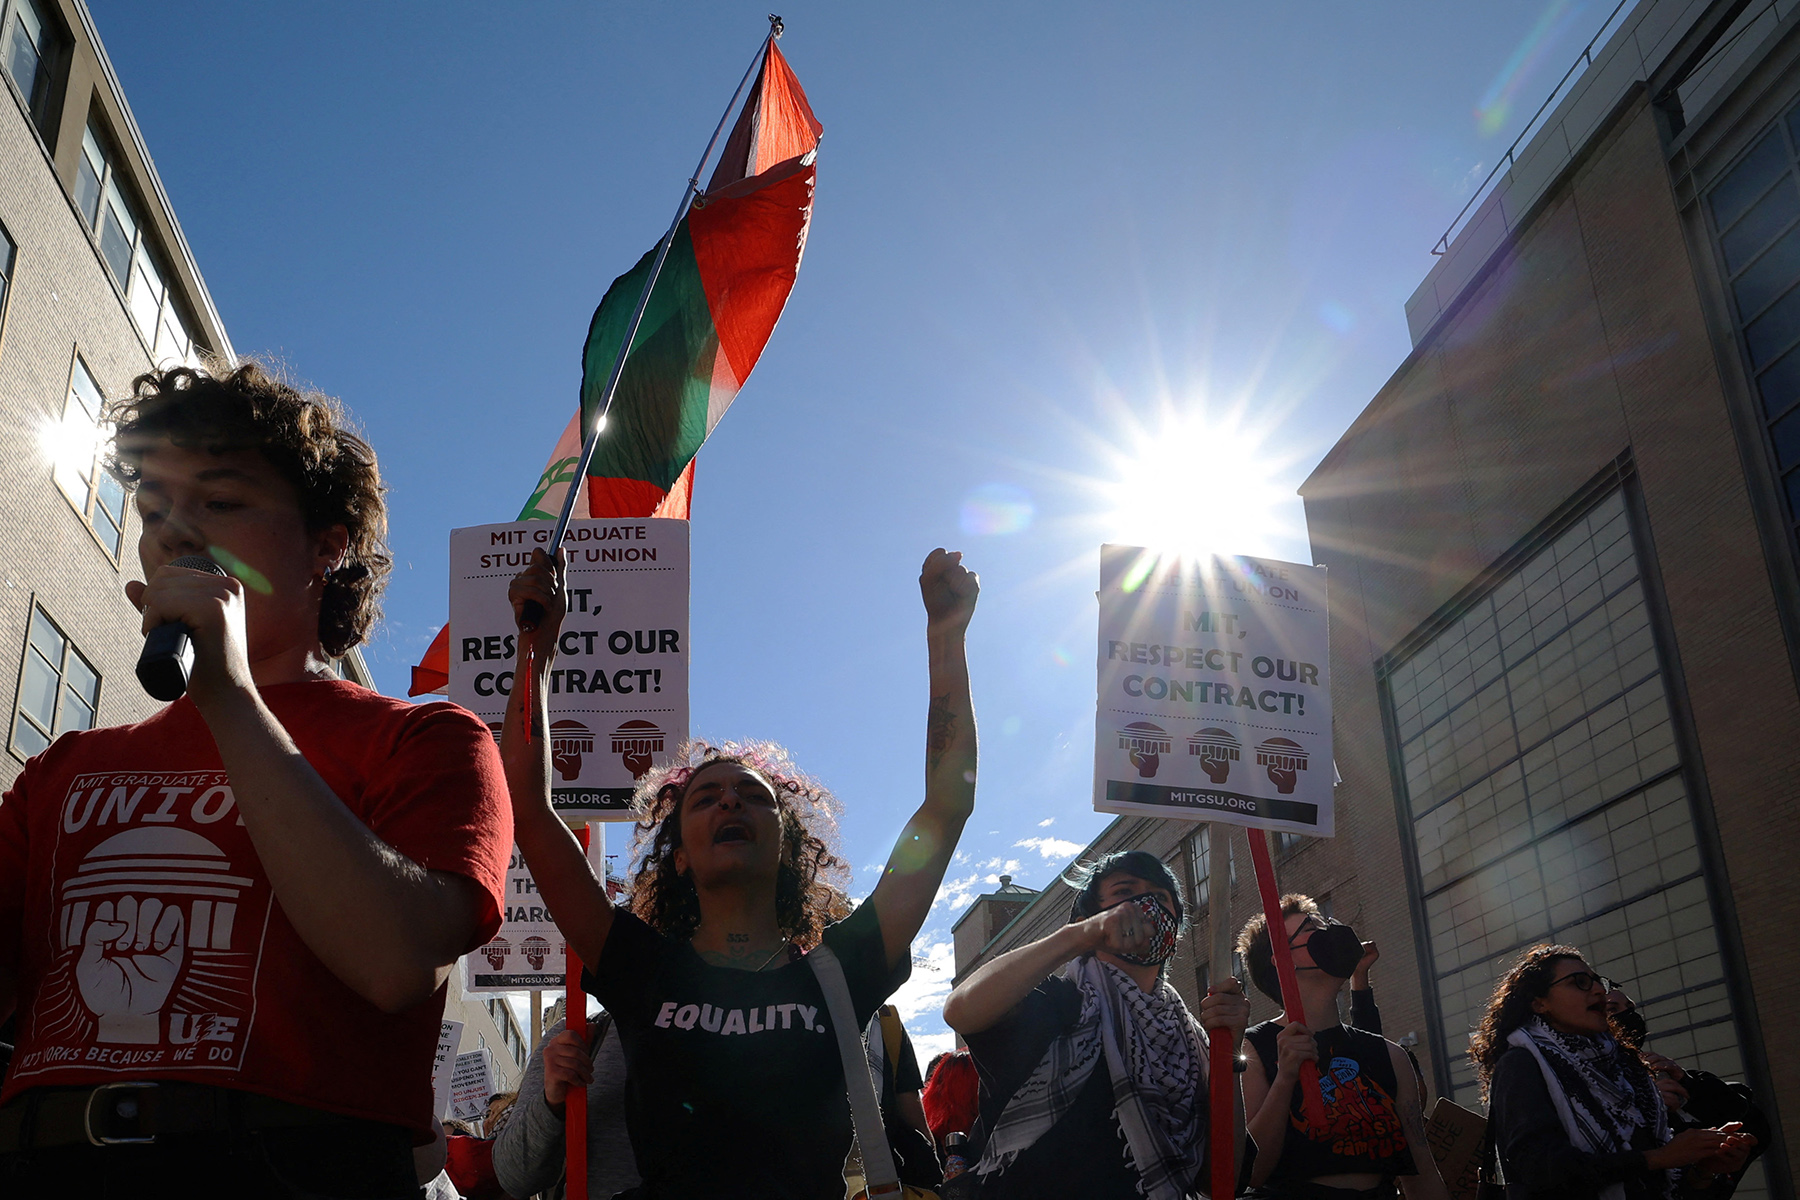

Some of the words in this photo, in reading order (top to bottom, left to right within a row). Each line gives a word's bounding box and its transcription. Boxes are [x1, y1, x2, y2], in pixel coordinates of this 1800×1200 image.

[491, 530, 526, 545] MIT
[533, 526, 646, 543] GADUATE
[481, 550, 579, 568] STUDT
[585, 548, 657, 563] UNION
[566, 589, 602, 616] IT,
[1183, 610, 1247, 639] MIT,
[462, 631, 599, 661] RESCT
[608, 629, 680, 655] OUR
[1108, 640, 1243, 673] RESPECT
[1251, 656, 1319, 686] OUR
[474, 669, 661, 697] COTRACT!
[1122, 674, 1305, 716] CONTRACT!
[76, 775, 109, 790] MIT
[111, 774, 209, 786] GRADUATE
[552, 793, 611, 804] GSU.ORG
[1170, 791, 1256, 811] MITGSU.ORG
[512, 878, 540, 894] TH
[511, 977, 560, 985] MITGSU.ORG
[654, 1002, 825, 1036] EQUALITY.
[85, 1047, 165, 1064] BECAUSE
[173, 1047, 197, 1060] WE
[208, 1047, 233, 1061] DO
[451, 1074, 474, 1083] USPEND
[1433, 1121, 1463, 1162] CIDE
